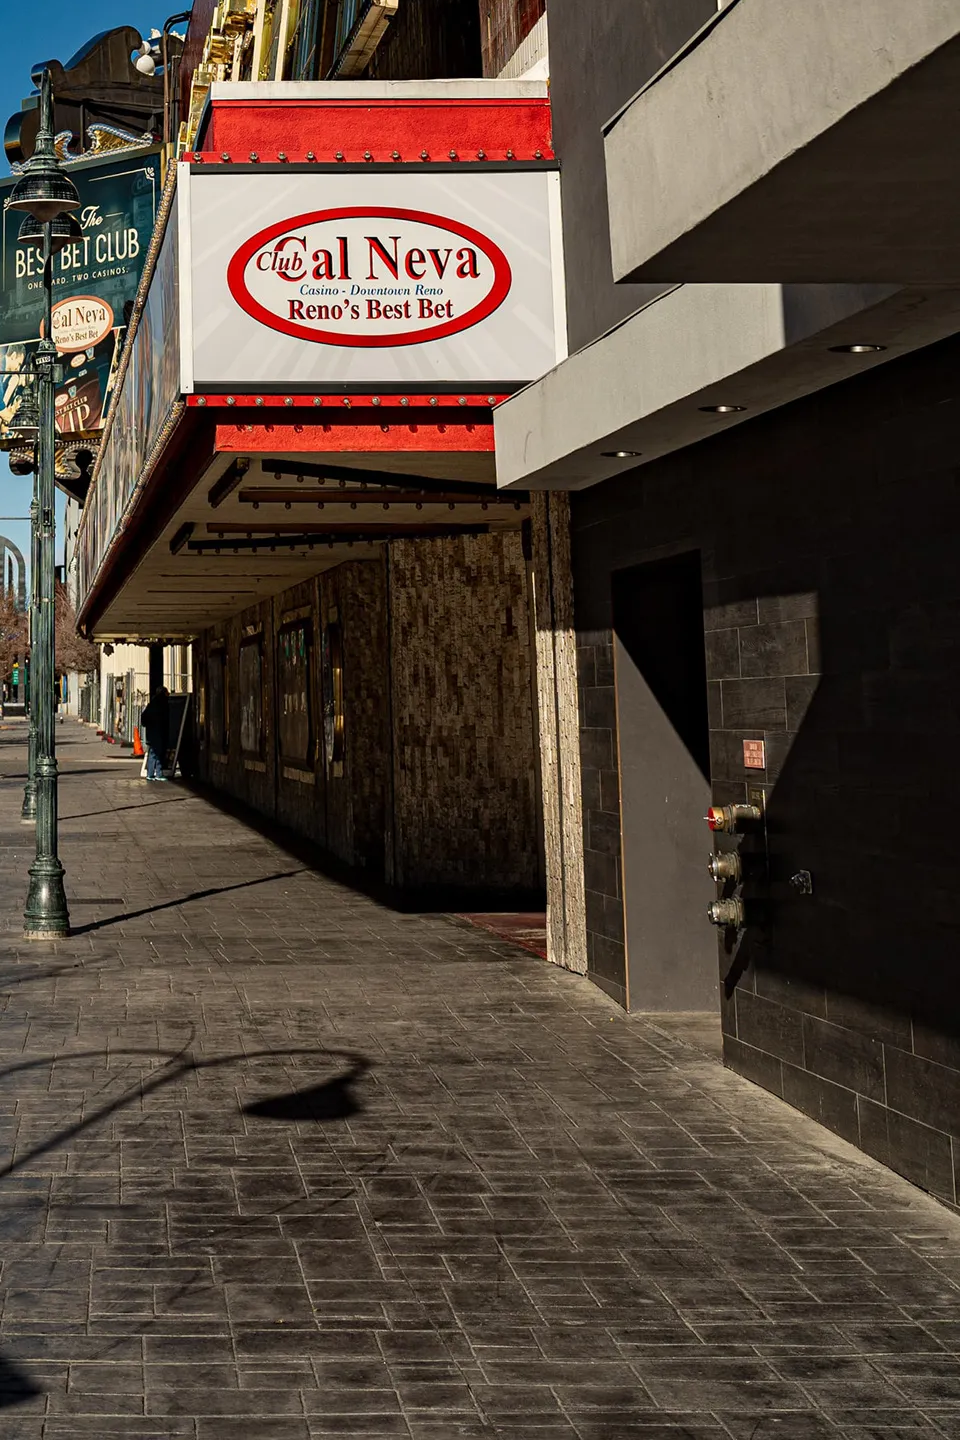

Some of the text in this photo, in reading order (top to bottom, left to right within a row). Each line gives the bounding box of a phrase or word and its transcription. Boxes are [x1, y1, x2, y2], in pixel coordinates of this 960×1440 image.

[80, 205, 104, 230] The
[15, 228, 140, 278] BES BET CLUB
[256, 236, 481, 282] Club Cal Neva
[28, 281, 43, 290] ONE
[72, 273, 89, 282] TWO
[92, 267, 129, 279] CASINOS.
[299, 284, 339, 296] Casino
[350, 284, 411, 296] Downtown
[415, 284, 444, 296] Reno
[52, 306, 106, 330] Cal Neva
[287, 298, 455, 320] Reno's Best Bet
